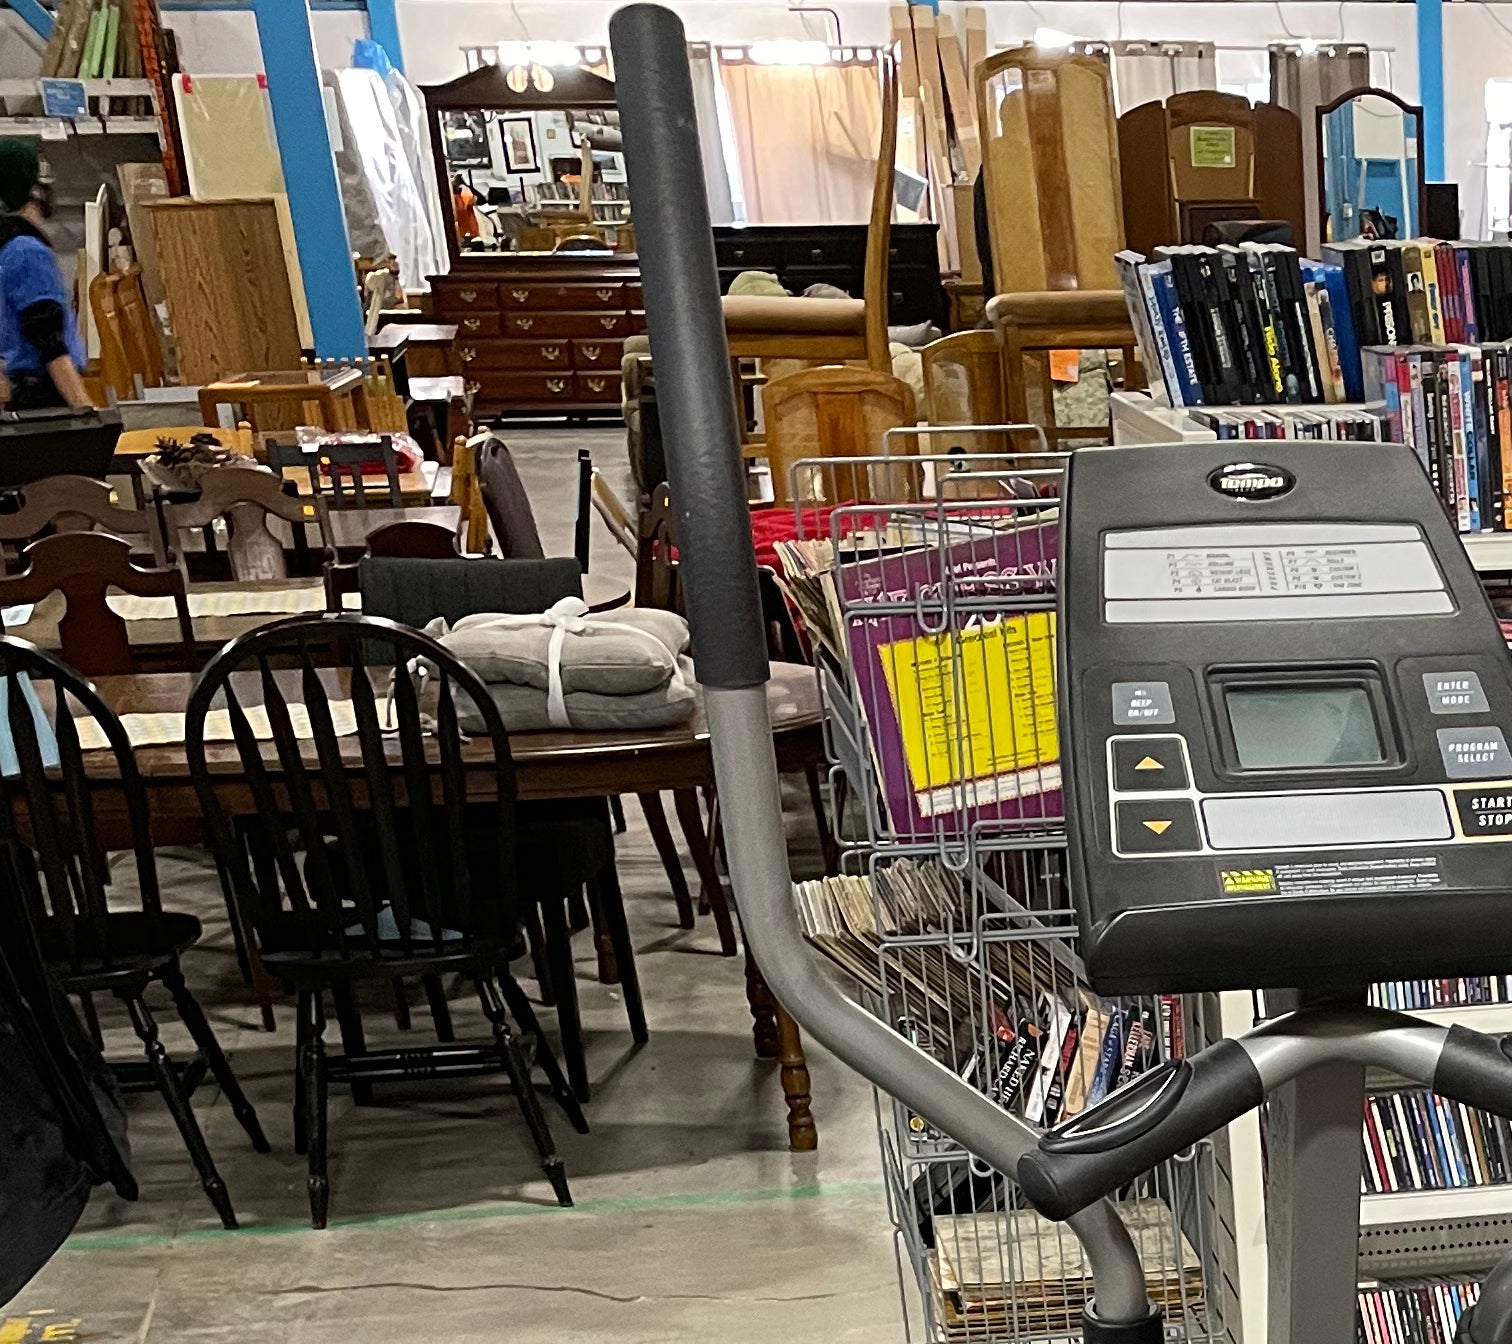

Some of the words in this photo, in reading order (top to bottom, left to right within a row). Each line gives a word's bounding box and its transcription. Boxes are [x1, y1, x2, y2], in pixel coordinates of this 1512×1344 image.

[1466, 430, 1477, 482] COLLAR
[1437, 681, 1469, 691] ENTER
[1130, 698, 1153, 708] BEEP
[1441, 695, 1471, 705] MODE
[1448, 741, 1498, 752] PROGRAM
[1457, 752, 1495, 763] SELECT
[1471, 796, 1512, 810] START
